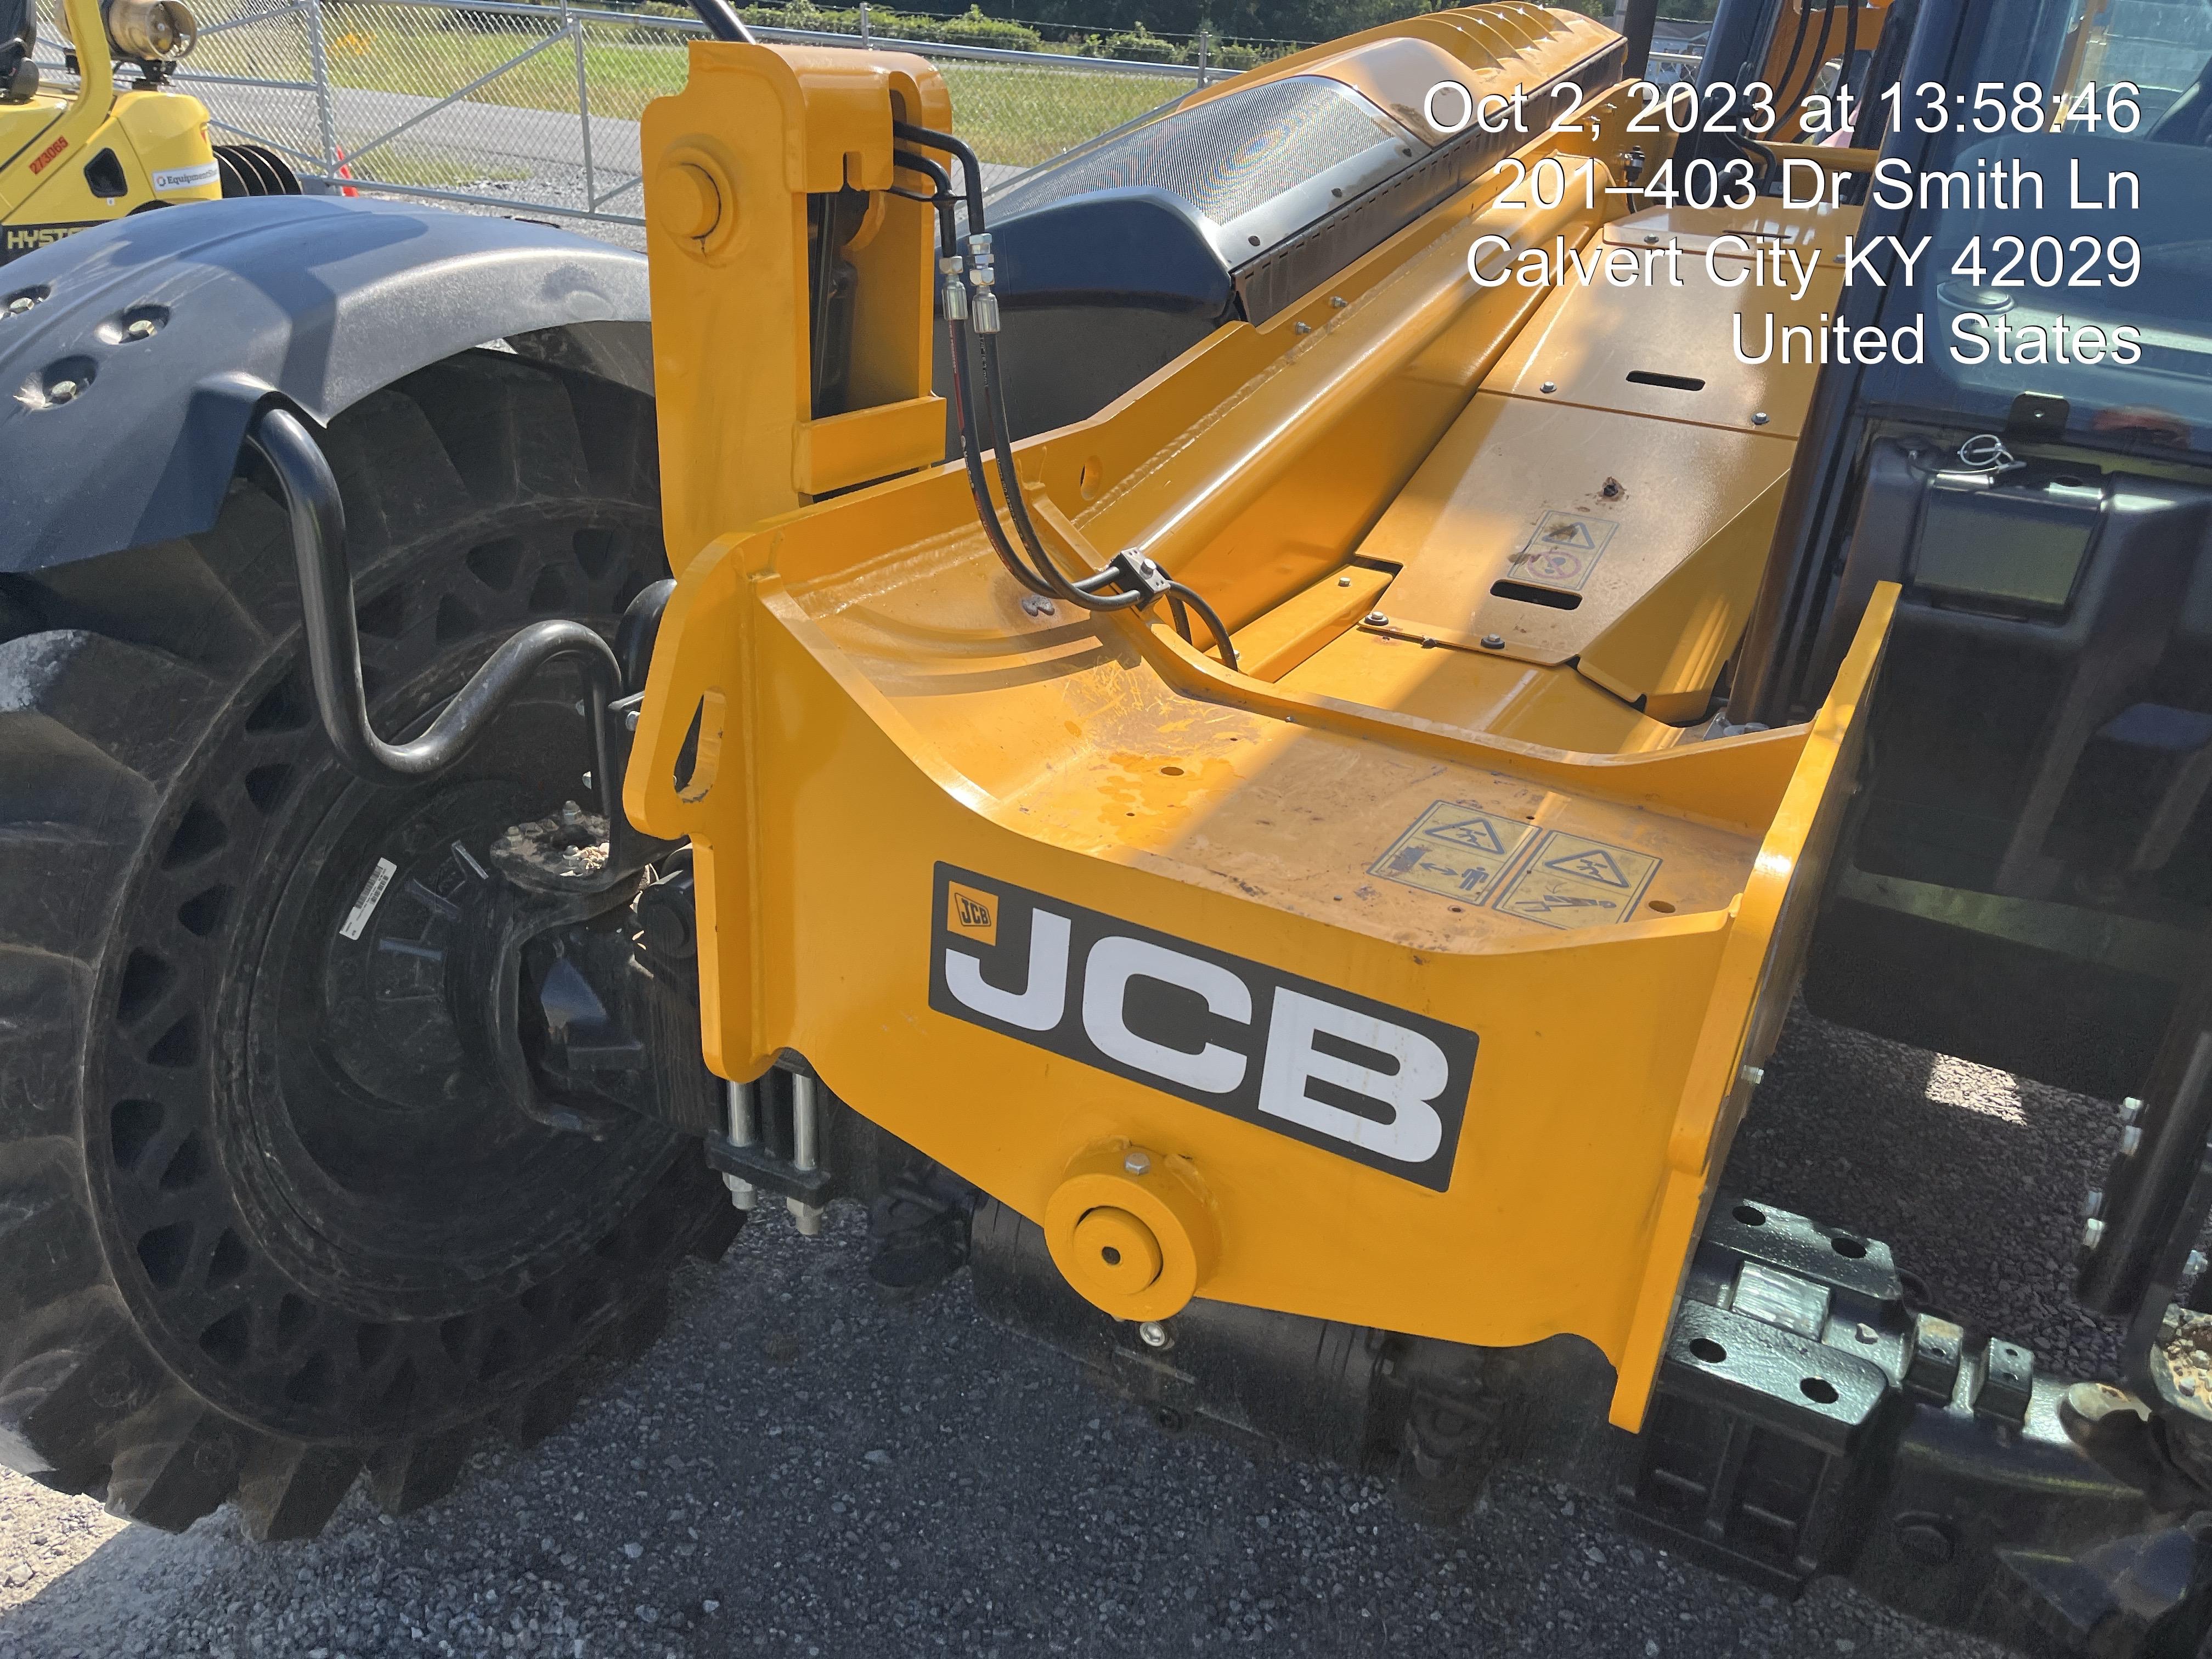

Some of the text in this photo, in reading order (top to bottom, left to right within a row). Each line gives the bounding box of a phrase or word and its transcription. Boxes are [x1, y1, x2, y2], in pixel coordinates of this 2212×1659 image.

[30, 136, 68, 174] 273065
[8, 226, 92, 249] HYST
[961, 898, 989, 924] JCB
[945, 907, 1449, 1163] JCB
